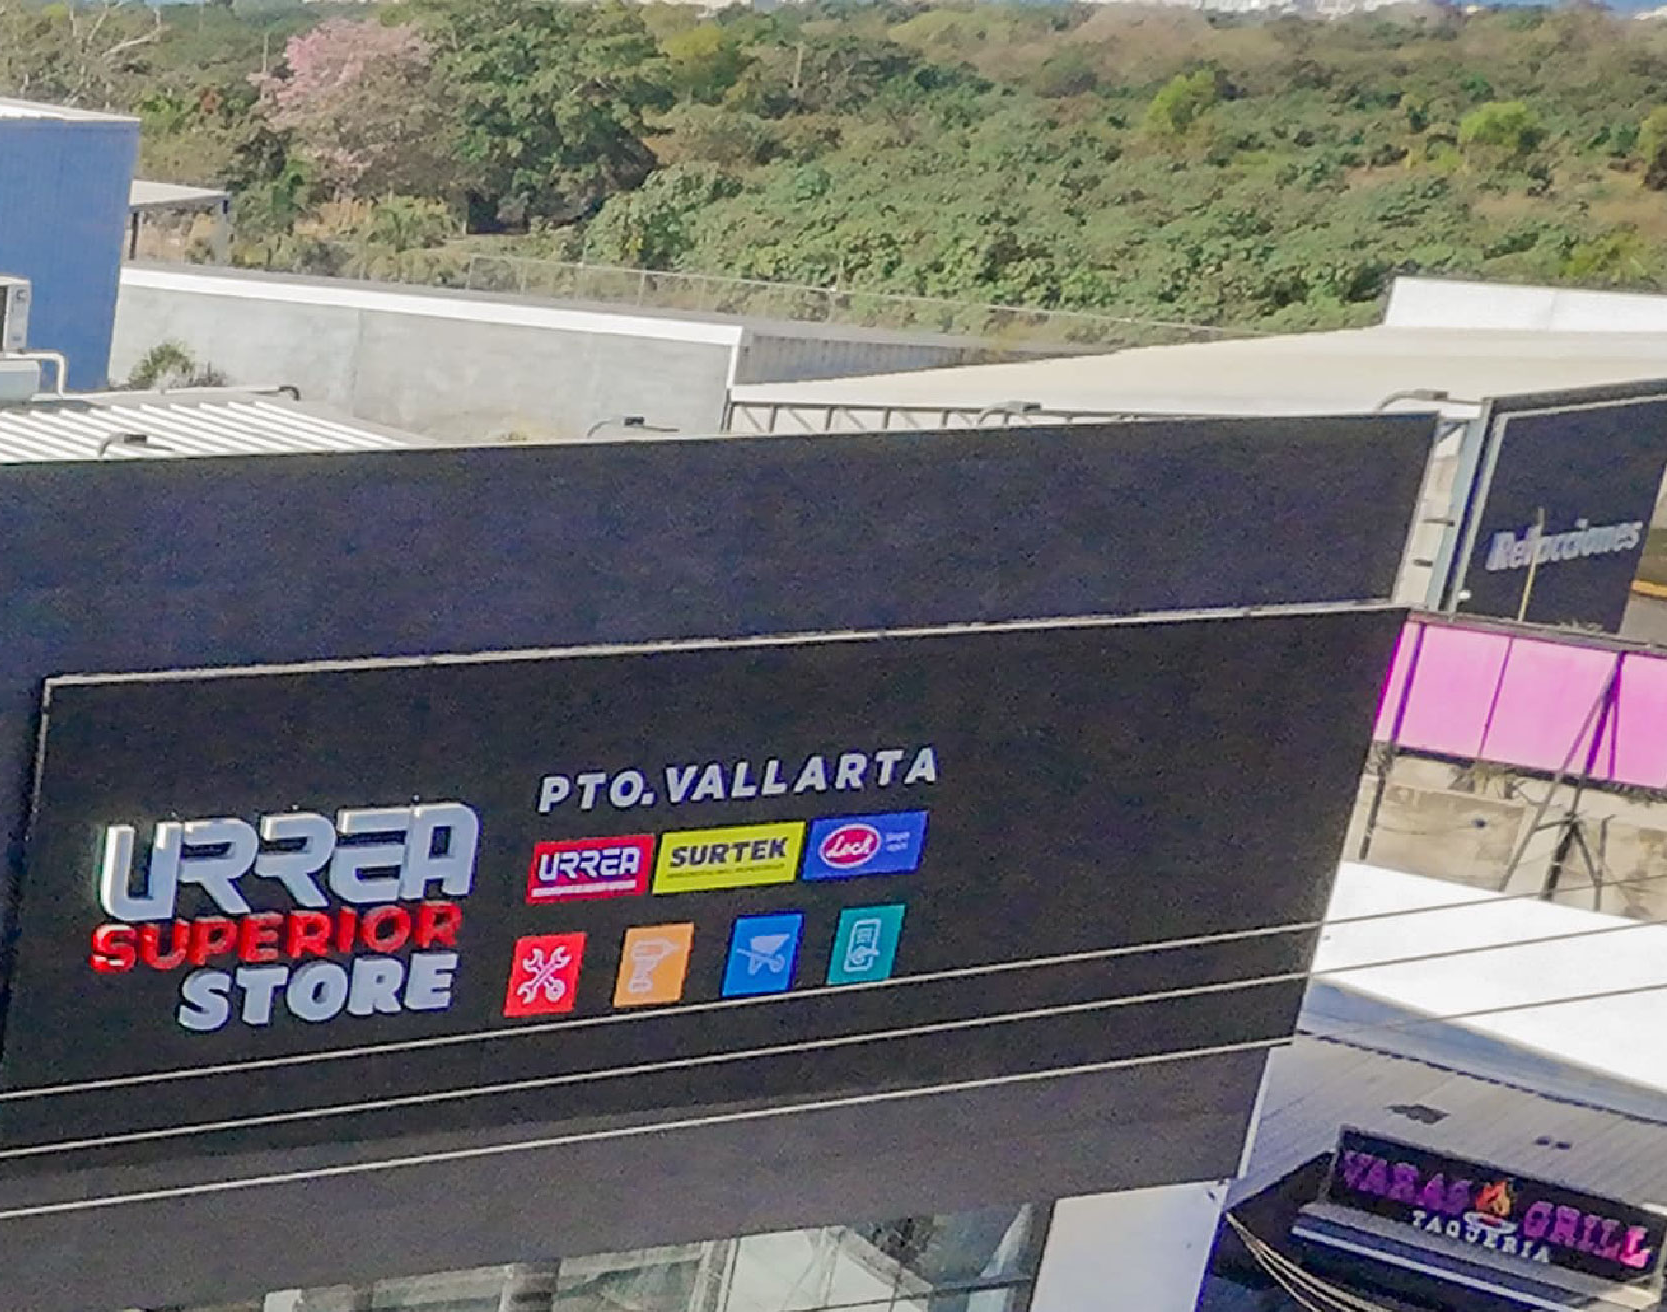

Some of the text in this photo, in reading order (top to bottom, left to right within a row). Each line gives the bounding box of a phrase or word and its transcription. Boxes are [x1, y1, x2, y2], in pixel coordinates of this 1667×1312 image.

[100, 801, 480, 922] URREA
[539, 846, 640, 881] URREA
[669, 836, 788, 869] SURTEK
[90, 901, 463, 974] SUPERIOR
[178, 953, 458, 1031] STORE
